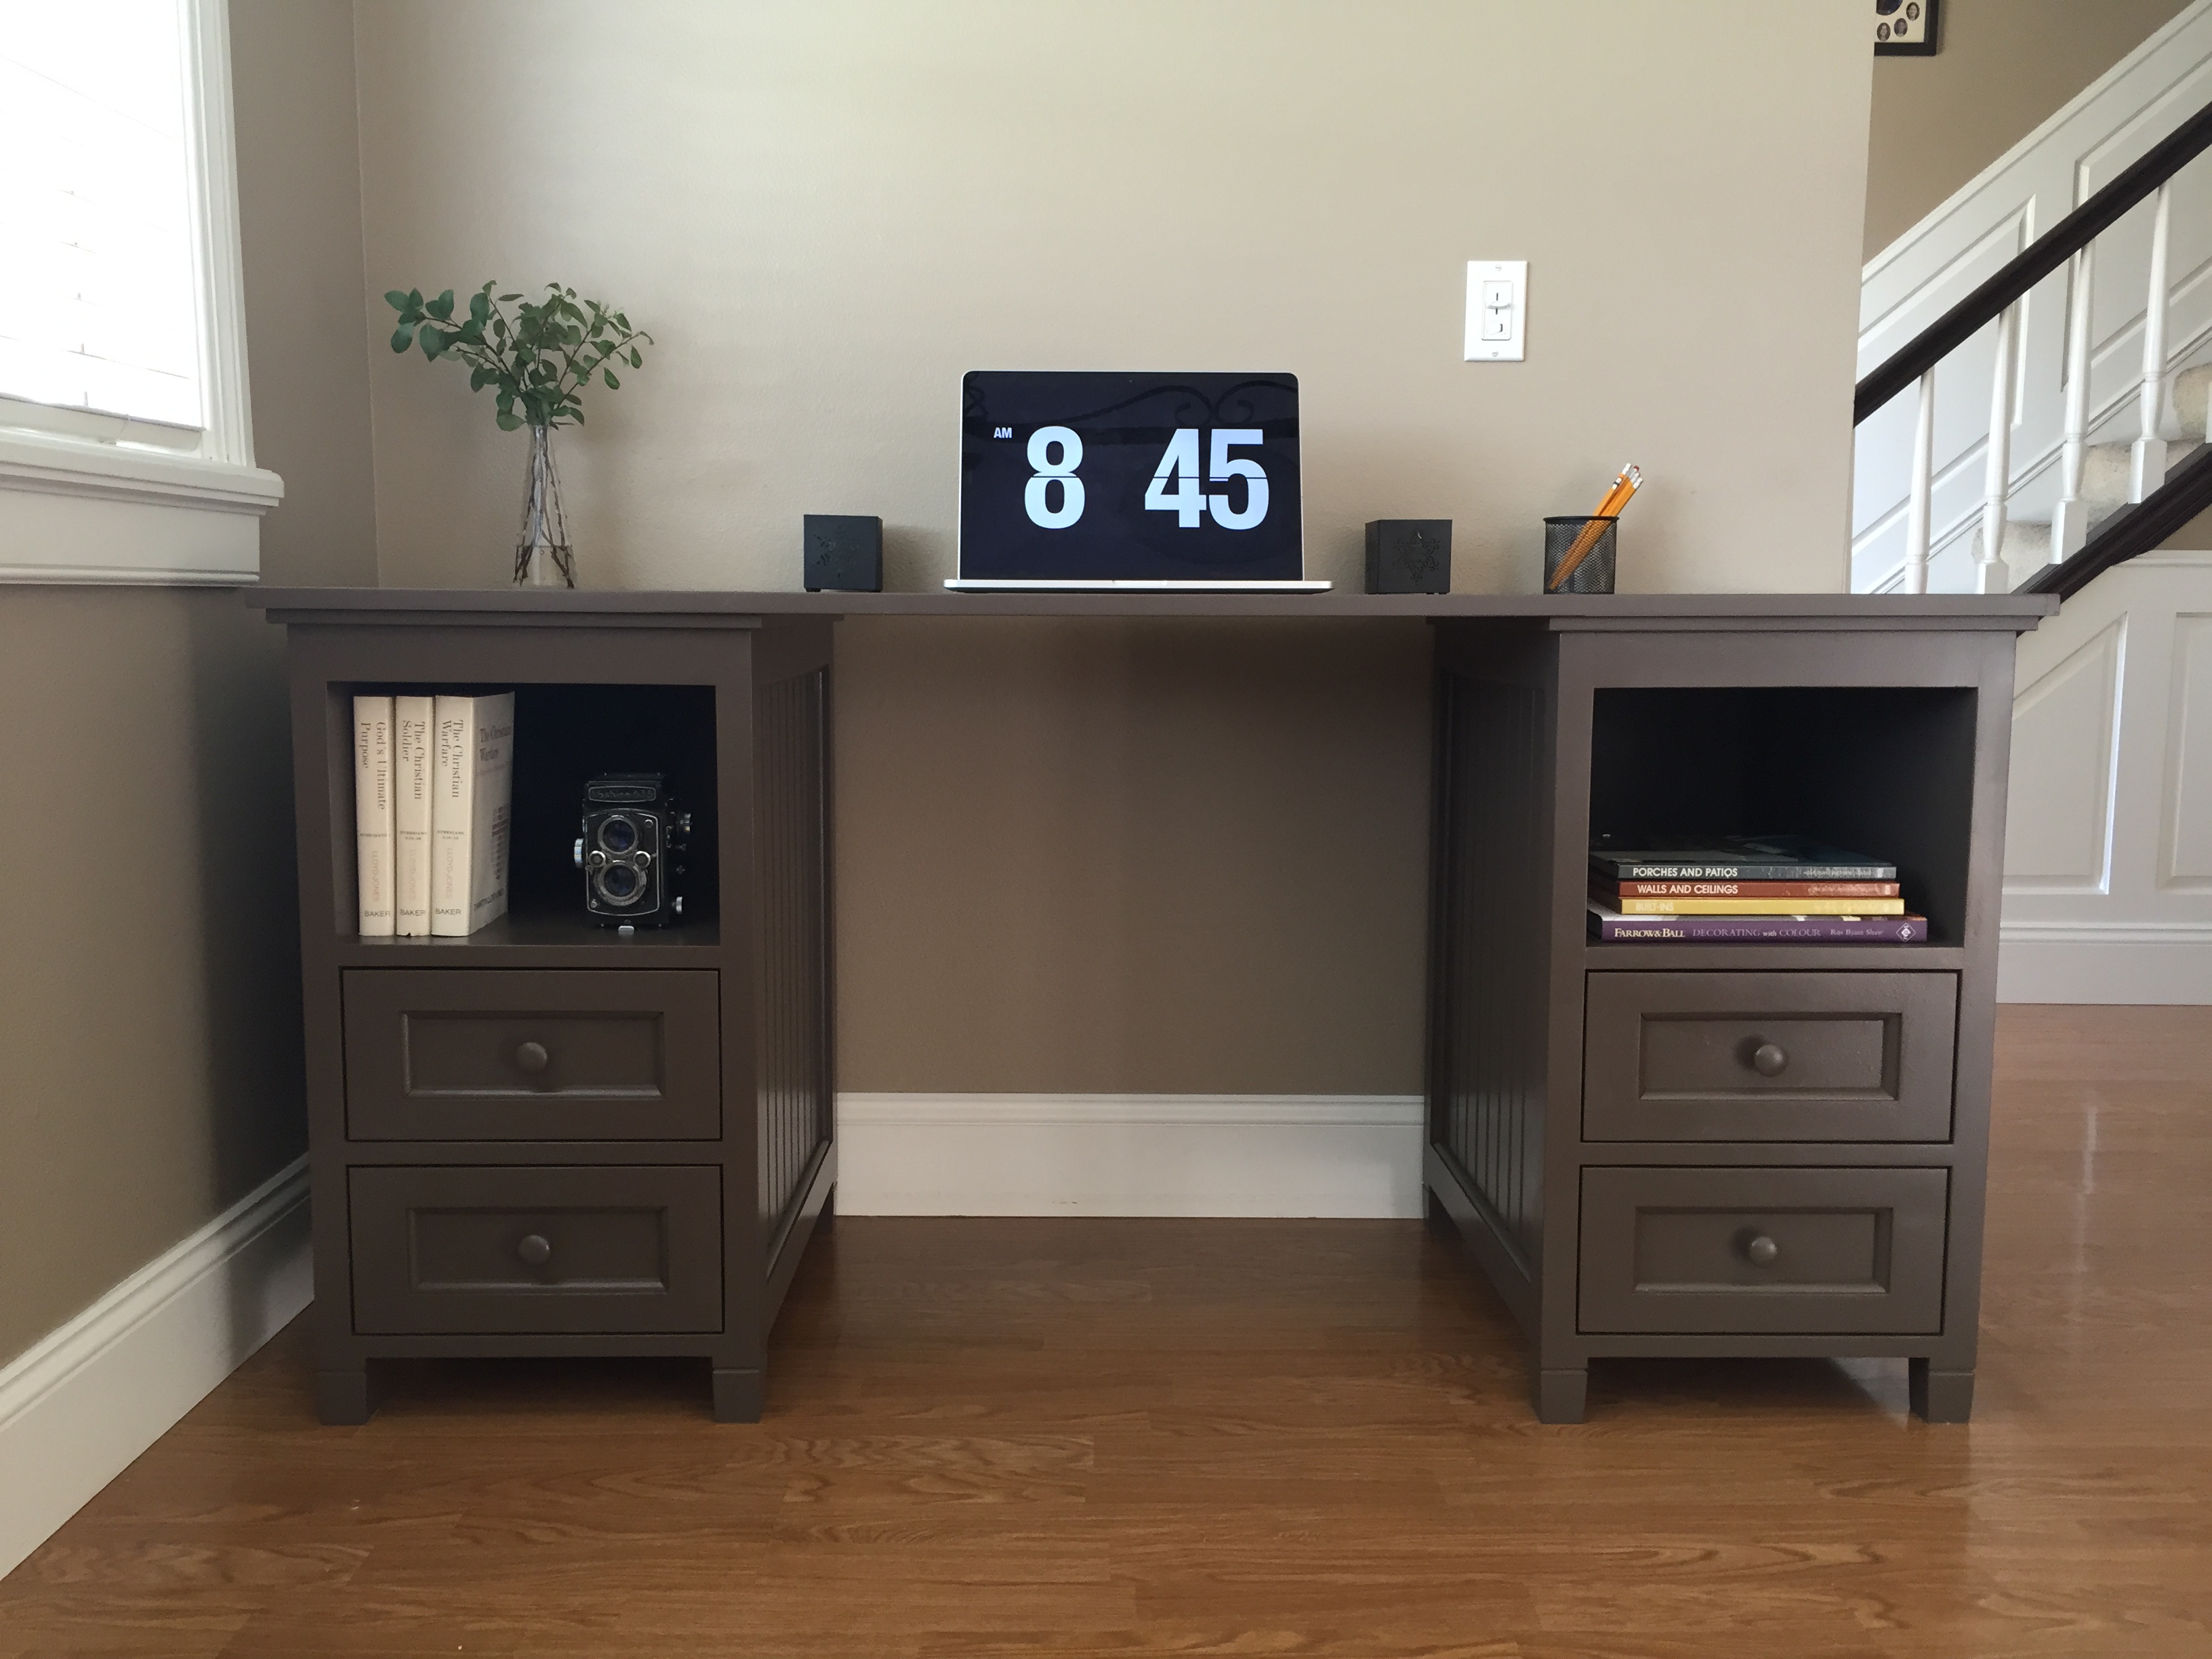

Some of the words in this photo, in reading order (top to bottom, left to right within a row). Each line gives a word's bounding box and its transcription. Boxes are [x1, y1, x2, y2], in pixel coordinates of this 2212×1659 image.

[993, 427, 1012, 438] AM
[1024, 426, 1085, 529] 8
[1145, 428, 1269, 530] 45
[359, 722, 371, 769] Purpose
[376, 721, 387, 756] God's
[402, 720, 411, 762] Soldier
[415, 721, 426, 744] The
[441, 720, 452, 767] Warfare
[453, 720, 464, 741] The
[377, 760, 388, 810] Ultimate
[414, 746, 425, 800] Christian
[452, 745, 464, 798] Christian
[445, 848, 453, 899] LLOYD-JONES
[1633, 867, 1678, 877] PORCHES
[1680, 867, 1702, 877] AND
[1705, 867, 1738, 878] PATIOS
[1637, 884, 1667, 894] WALLS
[1669, 884, 1692, 894] AND
[1694, 884, 1738, 895] CEILINGS
[1635, 902, 1674, 912] BUILT-INS
[1693, 928, 1761, 937] DECORATING
[1763, 928, 1777, 937] with
[1779, 928, 1821, 937] COLOUR
